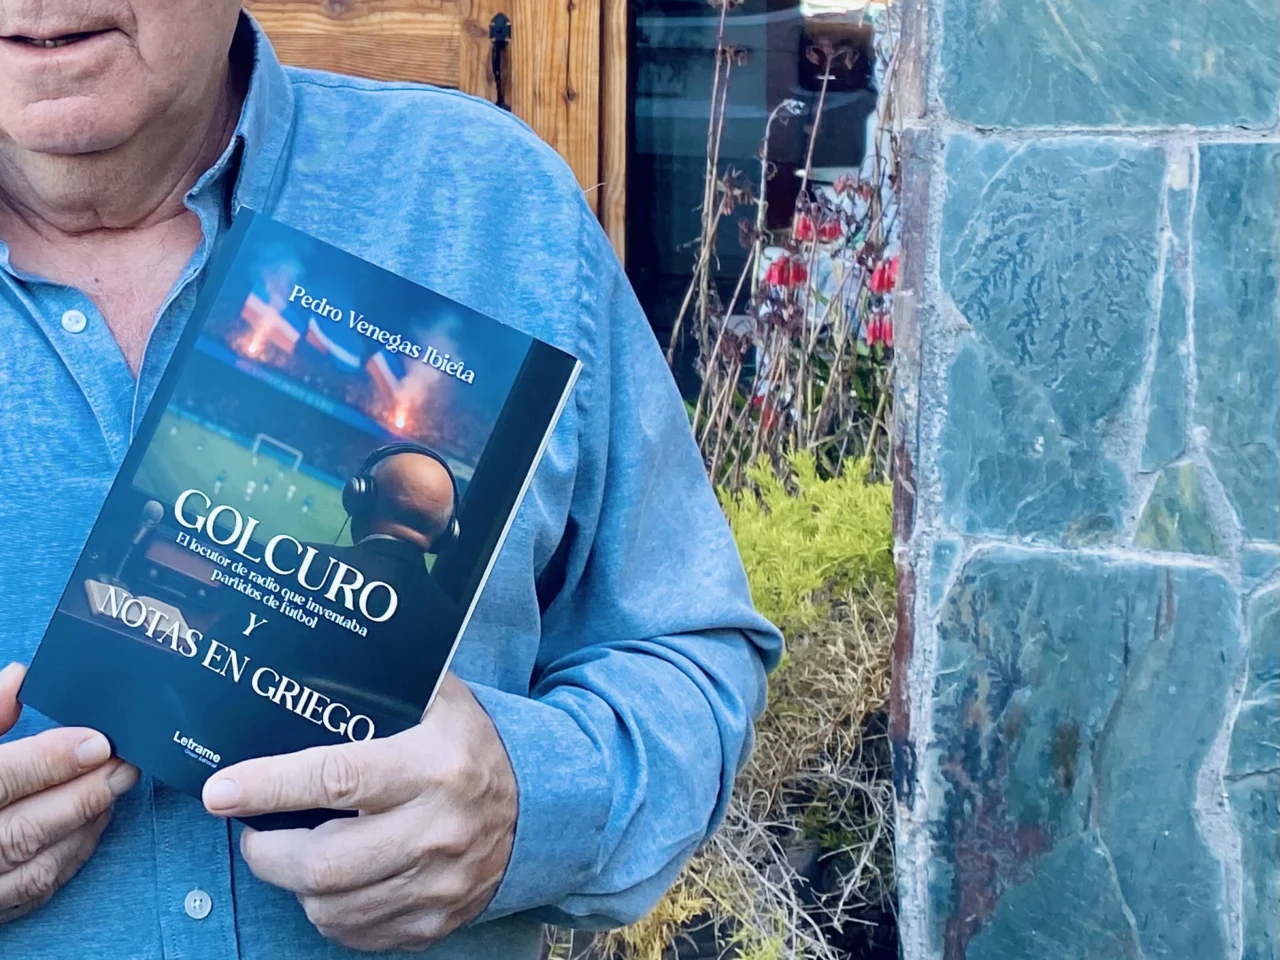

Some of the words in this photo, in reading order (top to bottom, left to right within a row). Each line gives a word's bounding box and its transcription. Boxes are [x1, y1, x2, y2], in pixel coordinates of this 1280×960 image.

[289, 284, 343, 322] Pedro
[349, 310, 422, 358] Venegas
[422, 346, 475, 384] Ibieta
[174, 489, 398, 622] GOLCURO
[176, 531, 190, 547] El
[189, 537, 231, 567] locutor
[231, 562, 248, 576] de
[248, 570, 280, 593] radio
[281, 587, 305, 606] que
[306, 597, 368, 637] inventaba
[210, 569, 262, 601] partidos
[262, 595, 280, 609] de
[279, 601, 318, 629] fútbol
[99, 585, 203, 658] NOTAS
[201, 639, 251, 683] EN
[251, 666, 375, 742] GRIEGO
[242, 612, 268, 637] Y
[173, 730, 221, 763] Letrame
